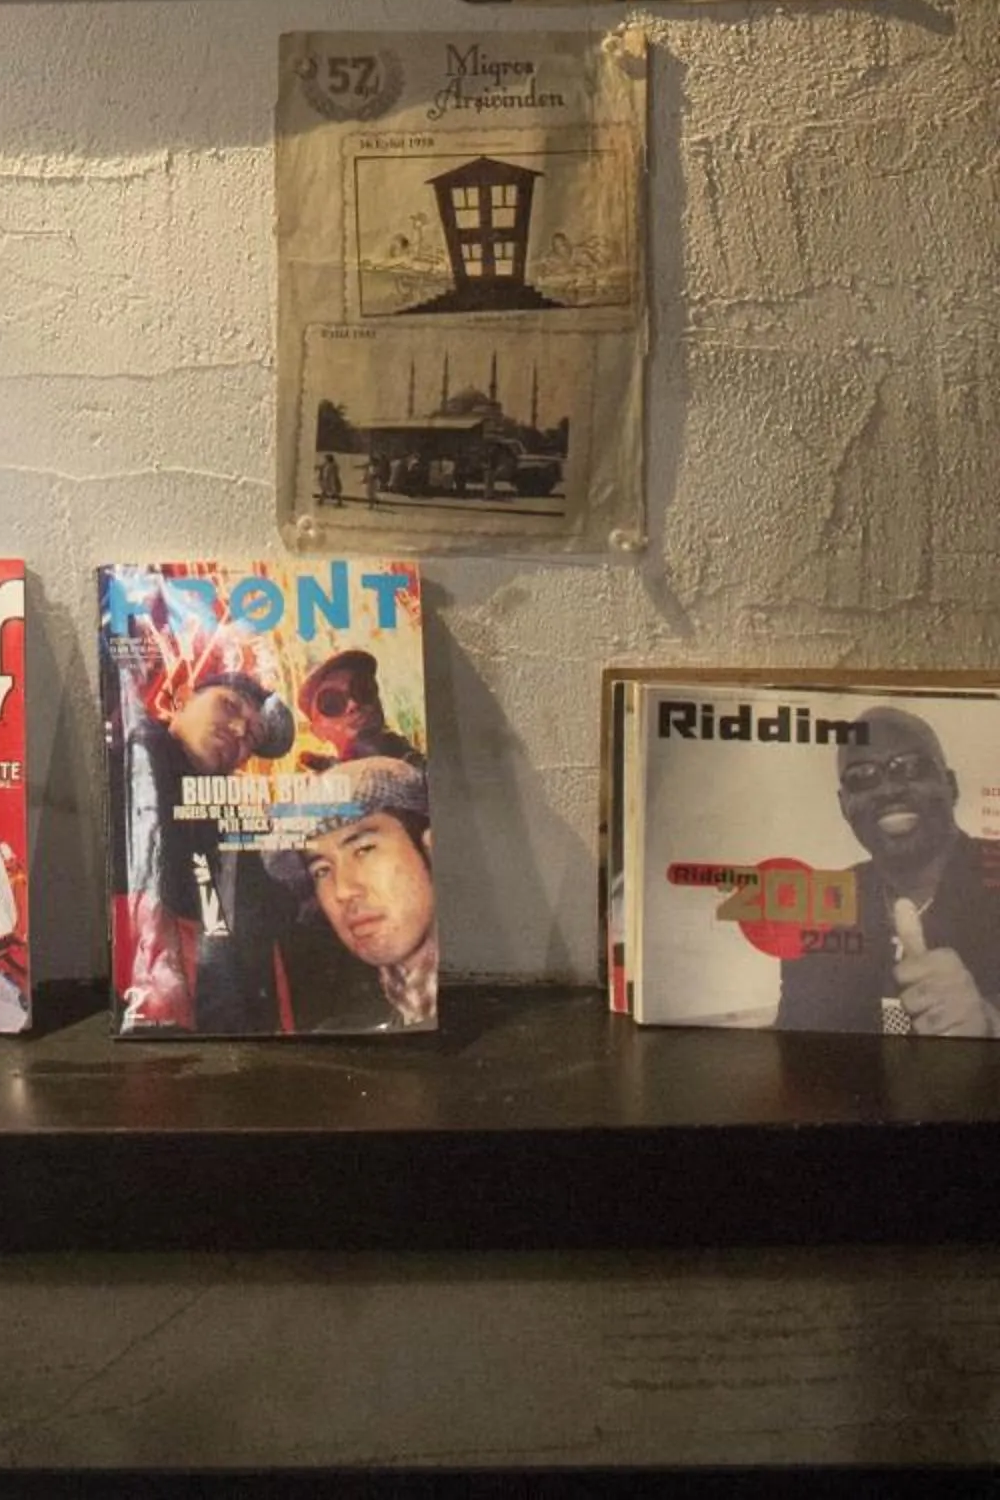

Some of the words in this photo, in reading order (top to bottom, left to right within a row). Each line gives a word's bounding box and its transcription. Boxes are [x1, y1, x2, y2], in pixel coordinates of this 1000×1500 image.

[446, 43, 534, 86] Migros
[658, 701, 872, 746] Riddim
[181, 775, 270, 805] BUDDHA
[673, 866, 759, 885] Riddim
